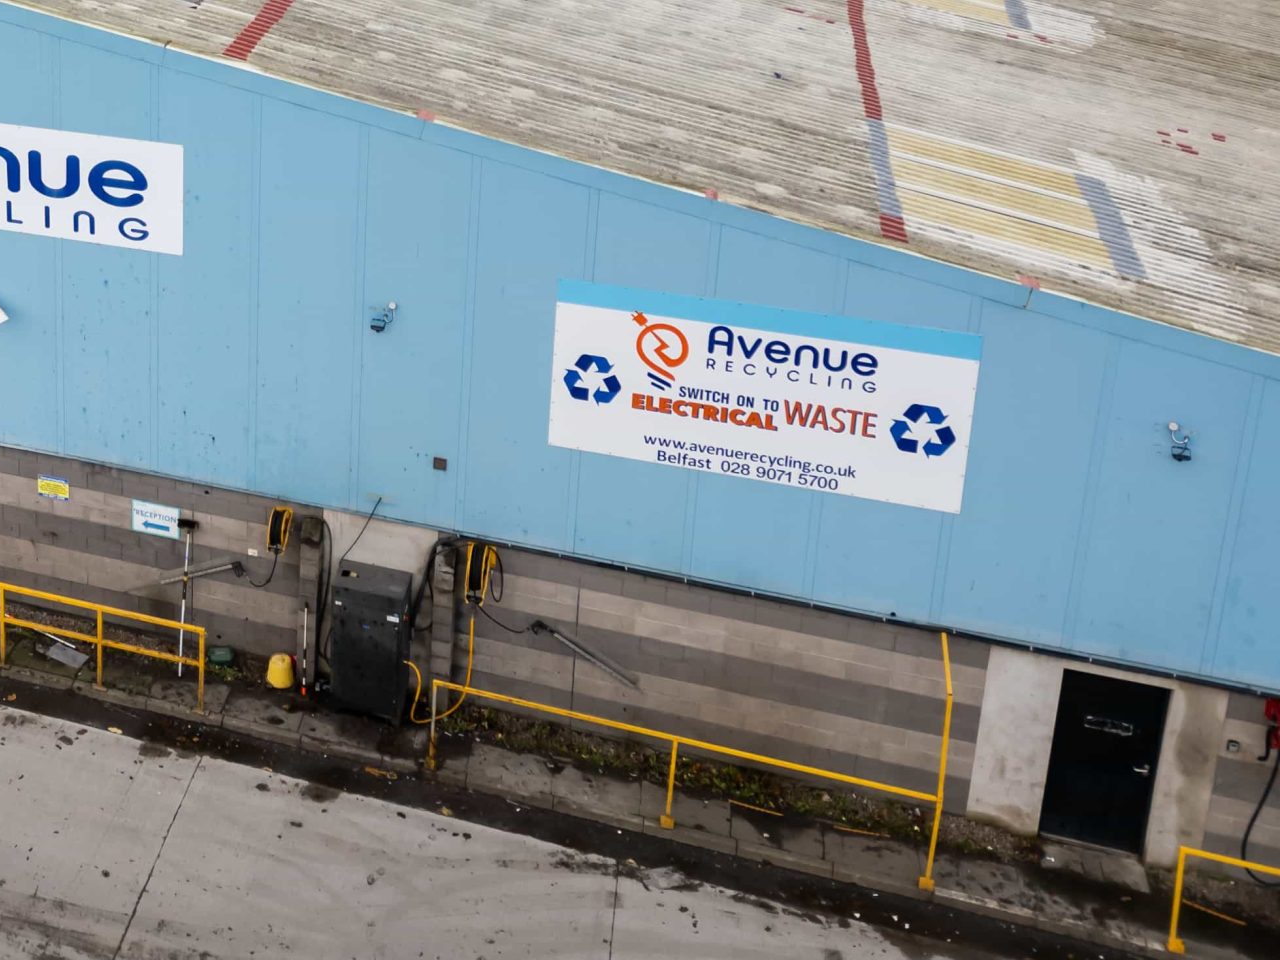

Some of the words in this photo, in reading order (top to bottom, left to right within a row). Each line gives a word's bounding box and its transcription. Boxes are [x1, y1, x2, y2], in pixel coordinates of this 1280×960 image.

[708, 326, 878, 377] Avenue
[706, 358, 877, 393] RECYCLING
[631, 393, 778, 431] ELECTRICAL
[784, 399, 878, 438] WASTE
[679, 386, 730, 404] SWITCH
[736, 395, 755, 408] ON
[763, 398, 780, 412] TO
[644, 435, 856, 478] www.avenuerecycling.co.uk
[657, 450, 712, 470] Belfast
[720, 460, 751, 476] 028
[756, 467, 792, 483] 9071
[798, 474, 839, 491] 5700
[136, 509, 177, 523] RECEPTION
